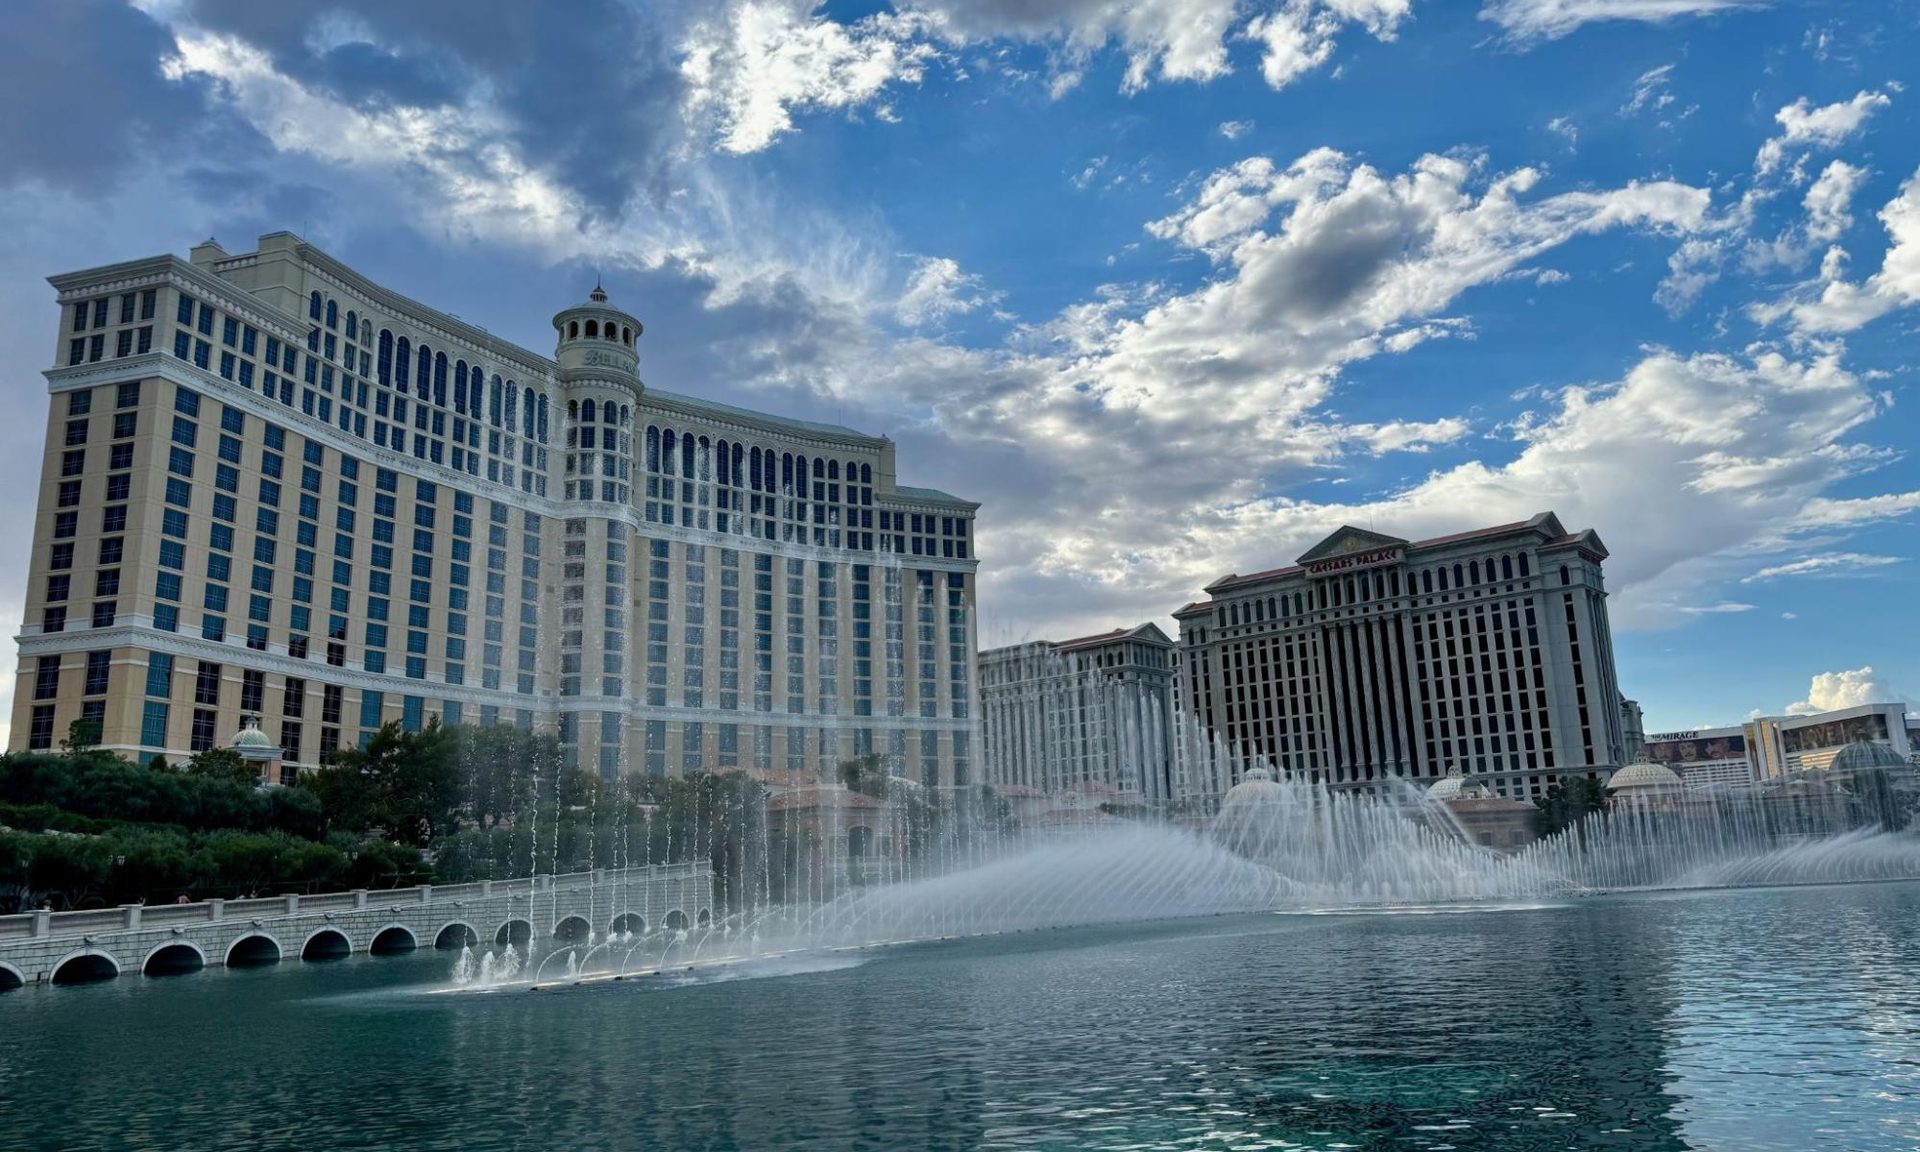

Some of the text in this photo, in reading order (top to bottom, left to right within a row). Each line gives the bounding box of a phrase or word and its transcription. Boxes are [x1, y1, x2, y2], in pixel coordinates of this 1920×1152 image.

[1310, 550, 1396, 573] CAESARS PALACE
[1661, 731, 1699, 740] MIRAGE
[1799, 726, 1837, 750] LOVE
